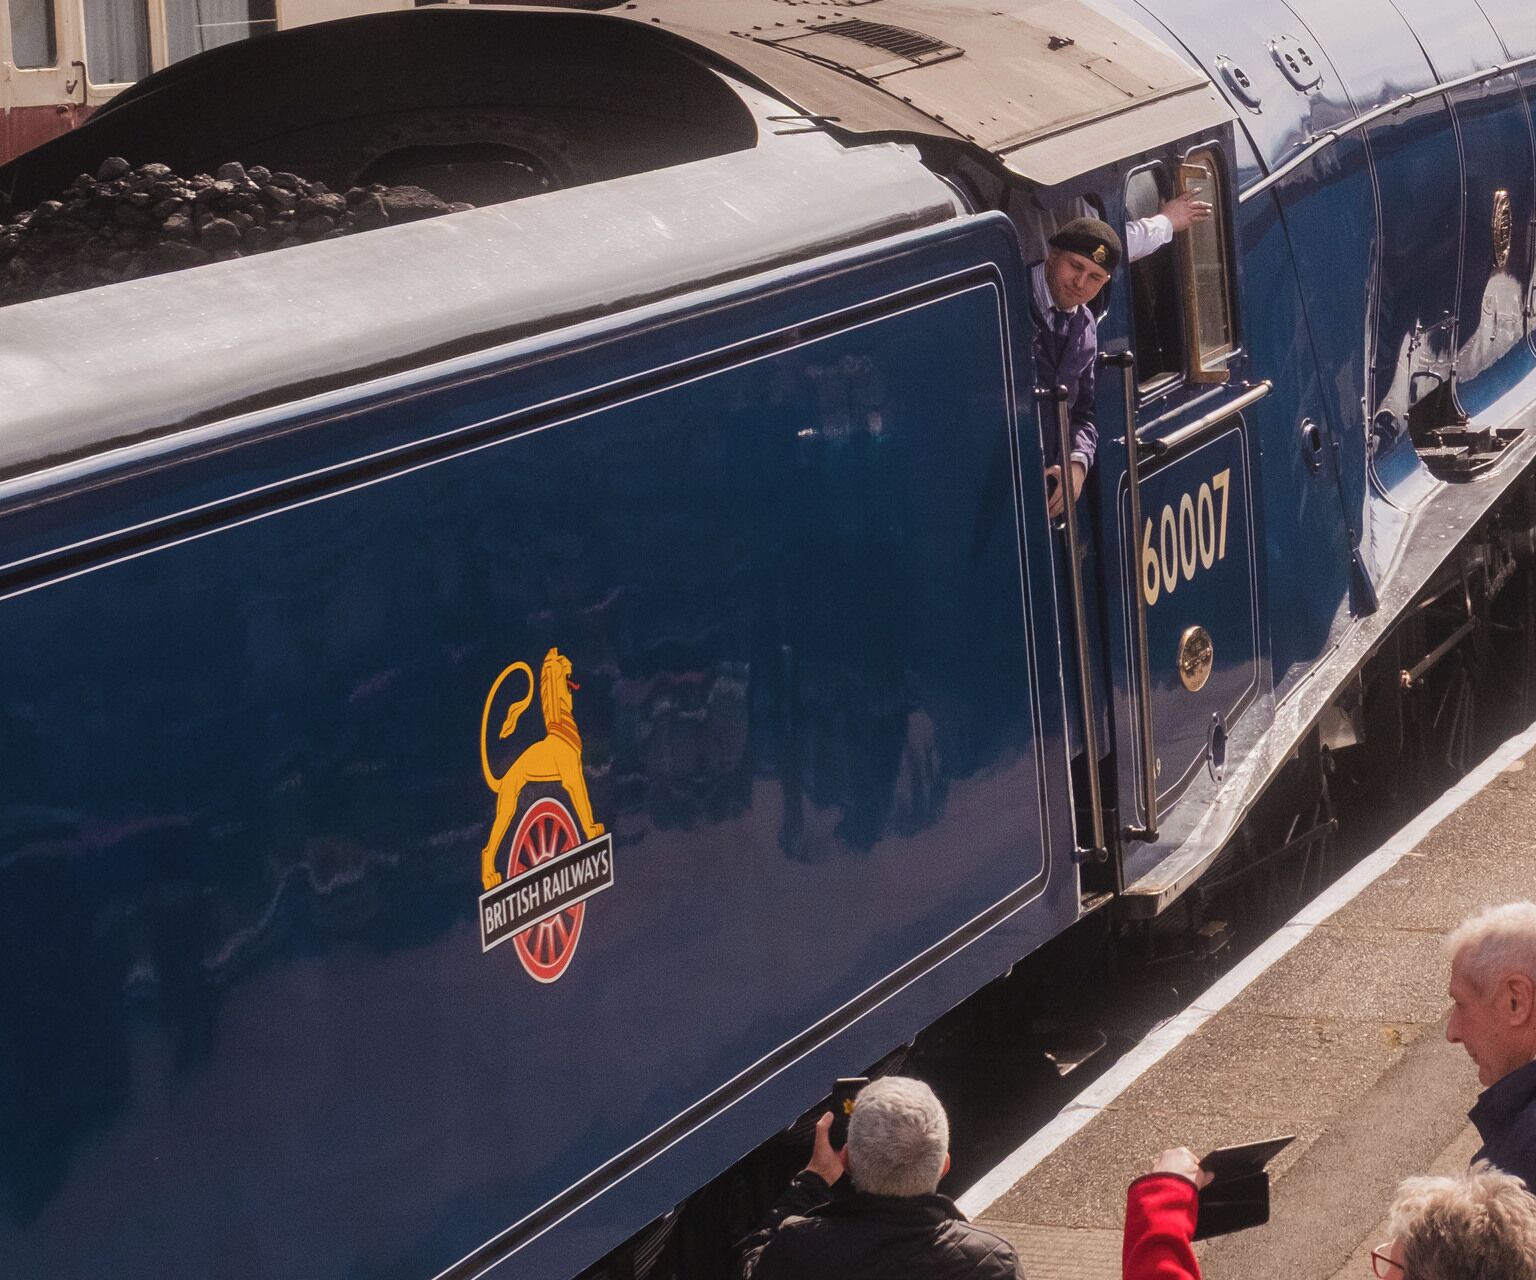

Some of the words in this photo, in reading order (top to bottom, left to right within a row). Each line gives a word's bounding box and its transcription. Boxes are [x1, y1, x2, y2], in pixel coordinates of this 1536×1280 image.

[1142, 468, 1230, 605] 60007
[484, 881, 540, 934] BRITISH
[543, 849, 609, 903] RAILWAYS
